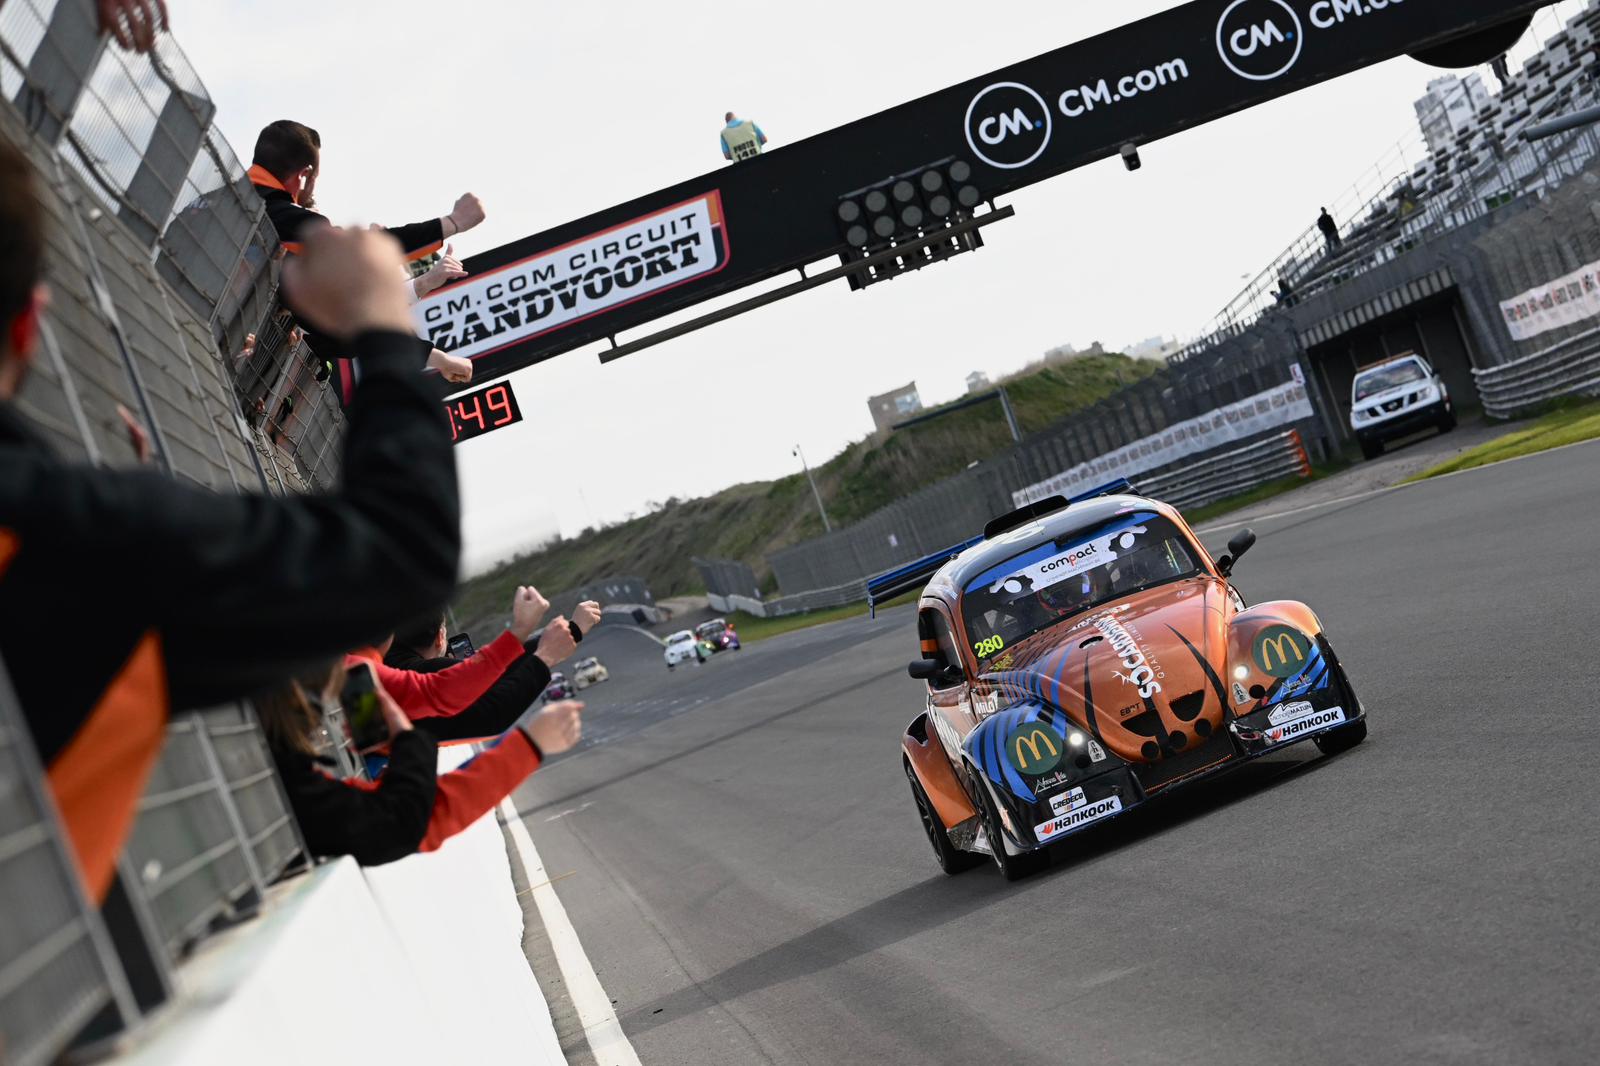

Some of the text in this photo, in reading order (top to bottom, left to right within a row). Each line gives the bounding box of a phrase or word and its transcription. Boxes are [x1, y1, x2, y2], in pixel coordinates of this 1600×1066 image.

[1058, 58, 1189, 117] CM.com
[425, 213, 697, 322] CM.COM CIRCUIT
[427, 232, 701, 353] ZANDVOORT
[1040, 543, 1097, 573] compact
[974, 634, 1004, 658] 280
[1052, 792, 1084, 810] CREDECO
